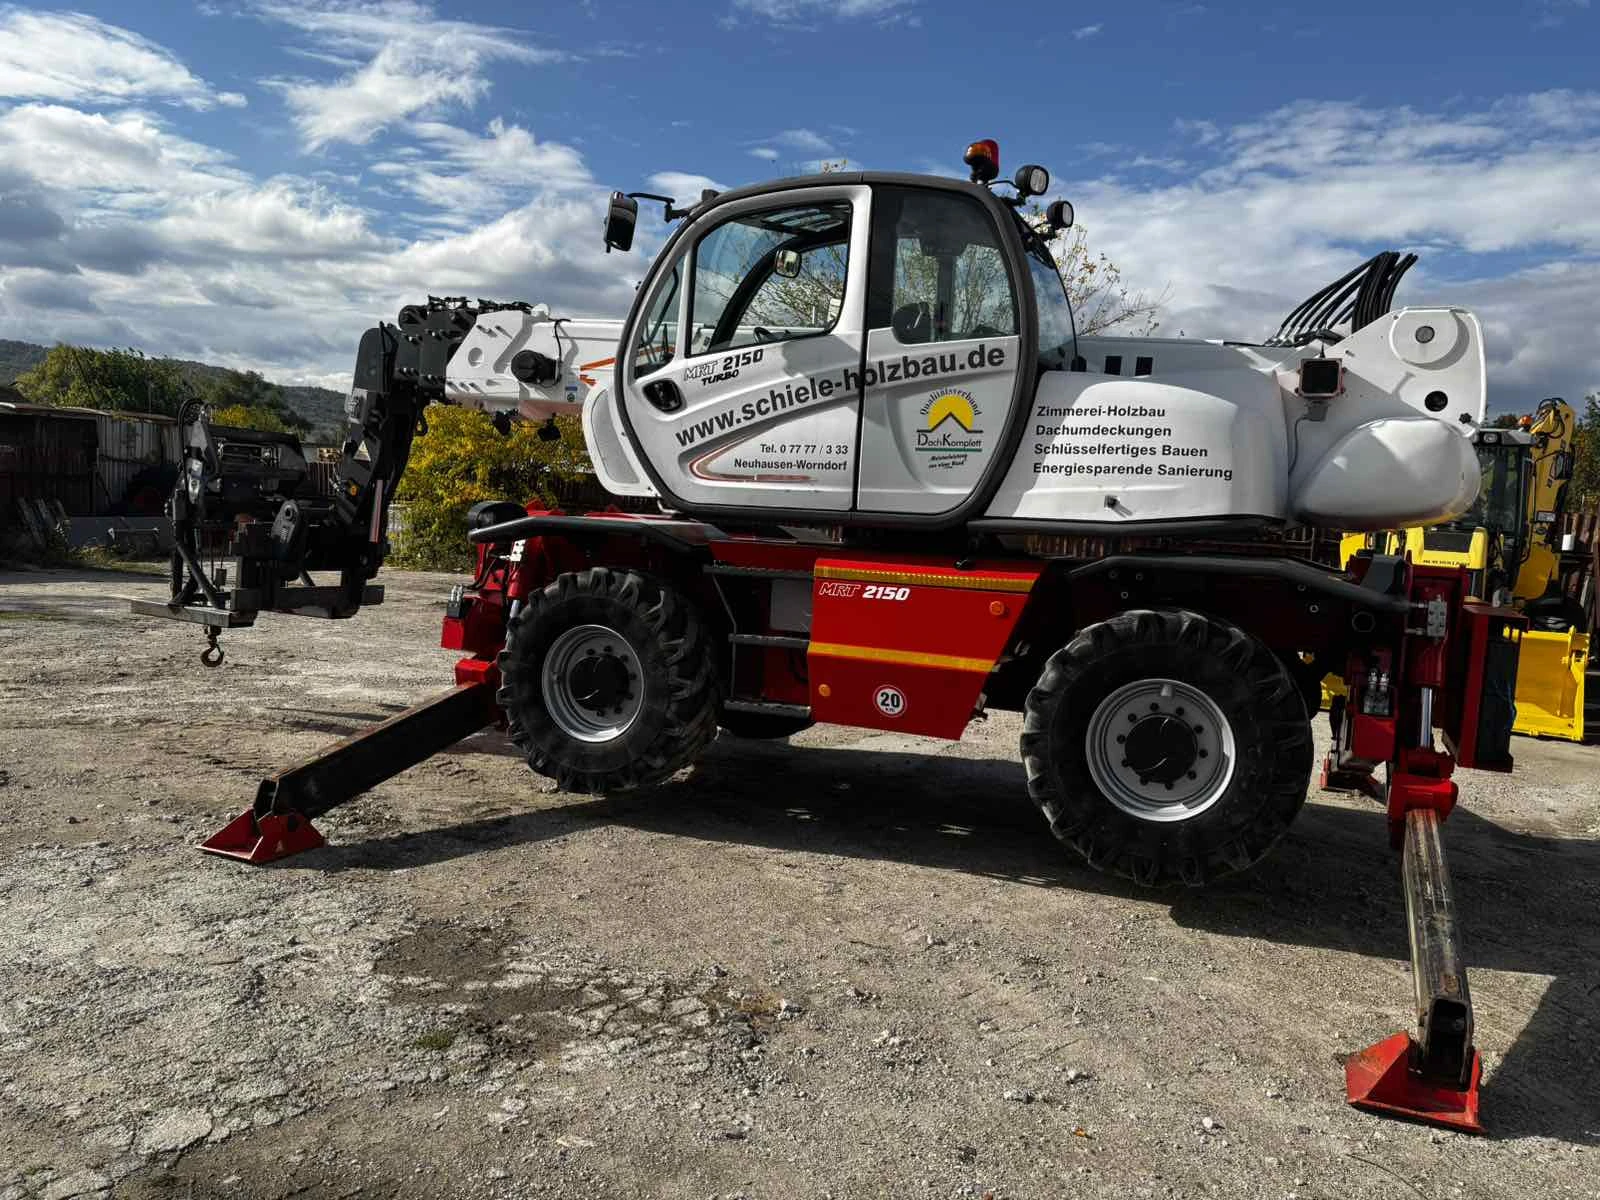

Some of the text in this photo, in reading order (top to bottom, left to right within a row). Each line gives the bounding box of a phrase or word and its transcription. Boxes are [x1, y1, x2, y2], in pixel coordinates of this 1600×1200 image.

[684, 349, 764, 380] MRT 2150
[702, 369, 739, 385] TURBO
[675, 344, 1006, 447] www.schiele-holzbau.de
[1037, 405, 1166, 418] Zimmerei-Holzbau
[1035, 425, 1172, 439] Dachumdeckungen
[760, 444, 776, 454] Tel.
[1034, 442, 1208, 458] Schlüsselfertiges Bauen
[734, 458, 848, 471] Neuhausen-Worndorf
[1033, 462, 1233, 481] Energiesparende Sanierung
[819, 582, 910, 601] MRT 2150
[880, 692, 901, 708] 20
